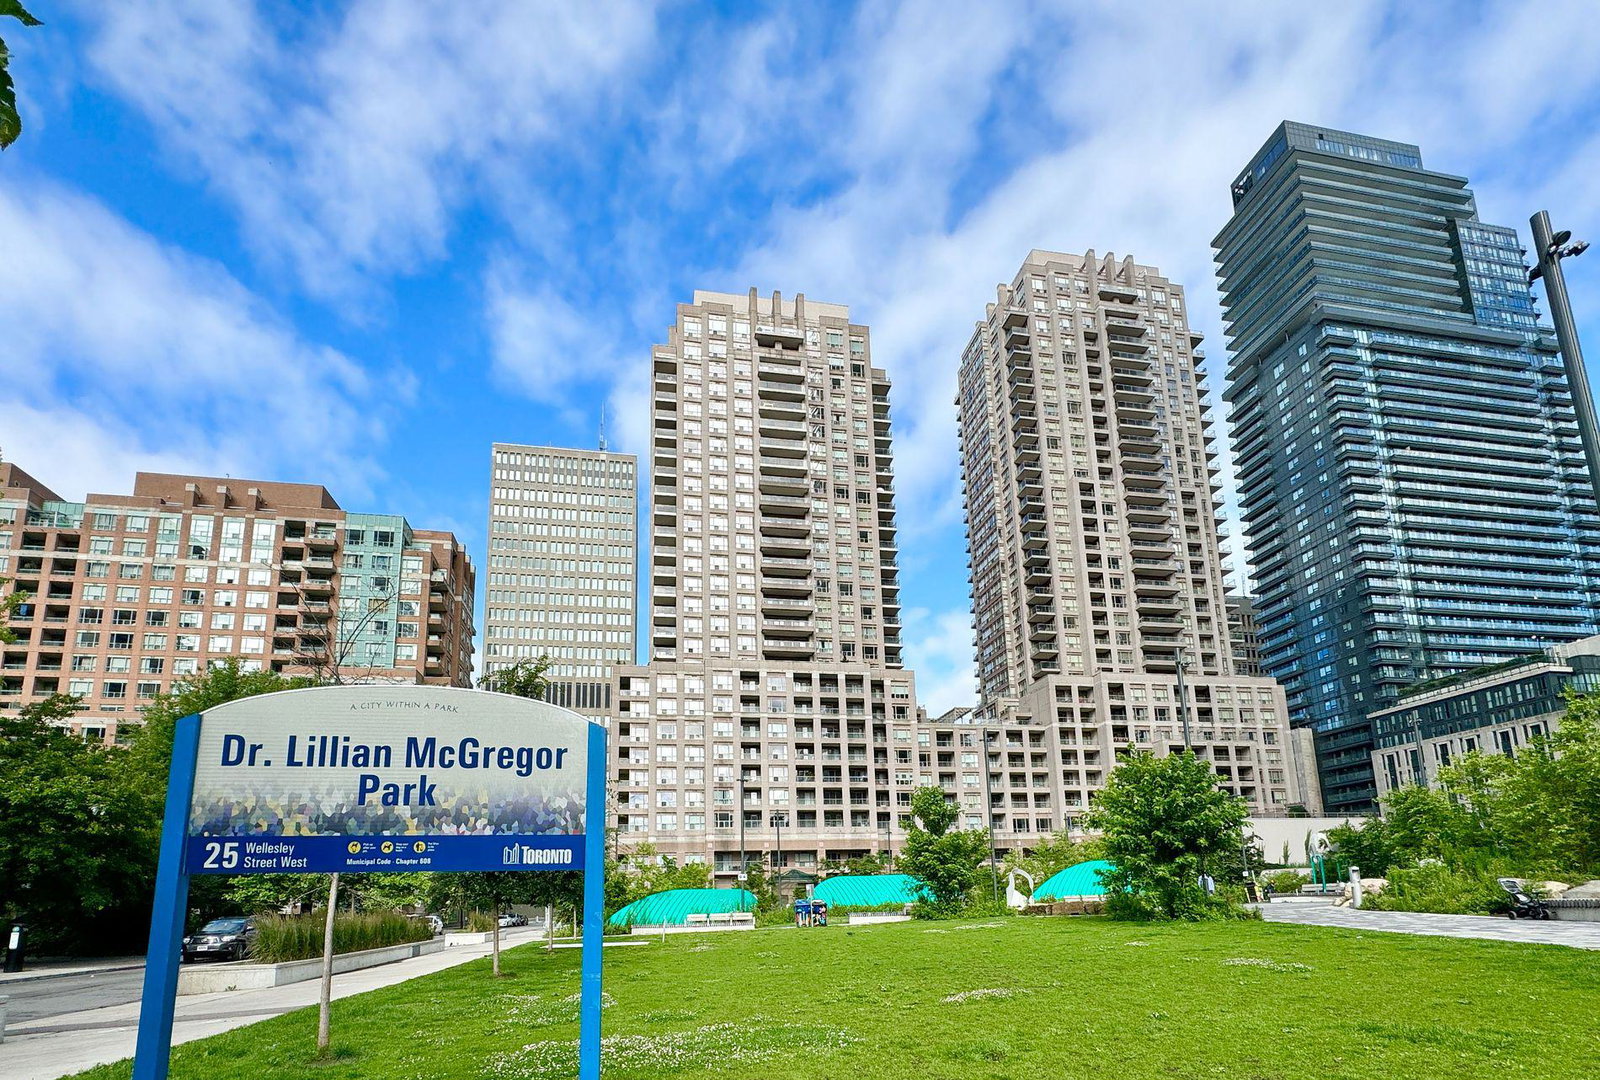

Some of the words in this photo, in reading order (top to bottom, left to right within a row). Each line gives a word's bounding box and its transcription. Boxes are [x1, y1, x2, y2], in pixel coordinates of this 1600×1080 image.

[360, 702, 382, 710] CITY
[434, 703, 459, 713] PARK
[221, 734, 272, 767] Dr.
[286, 735, 392, 768] Lillian
[405, 736, 568, 777] McGregor
[357, 774, 437, 806] Park
[203, 842, 239, 869] 25
[246, 842, 295, 855] Wellesley
[521, 845, 572, 864] TORONTO
[243, 856, 277, 868] Street
[281, 856, 308, 868] West
[346, 858, 376, 866] Municipal
[396, 858, 418, 866] Chapter
